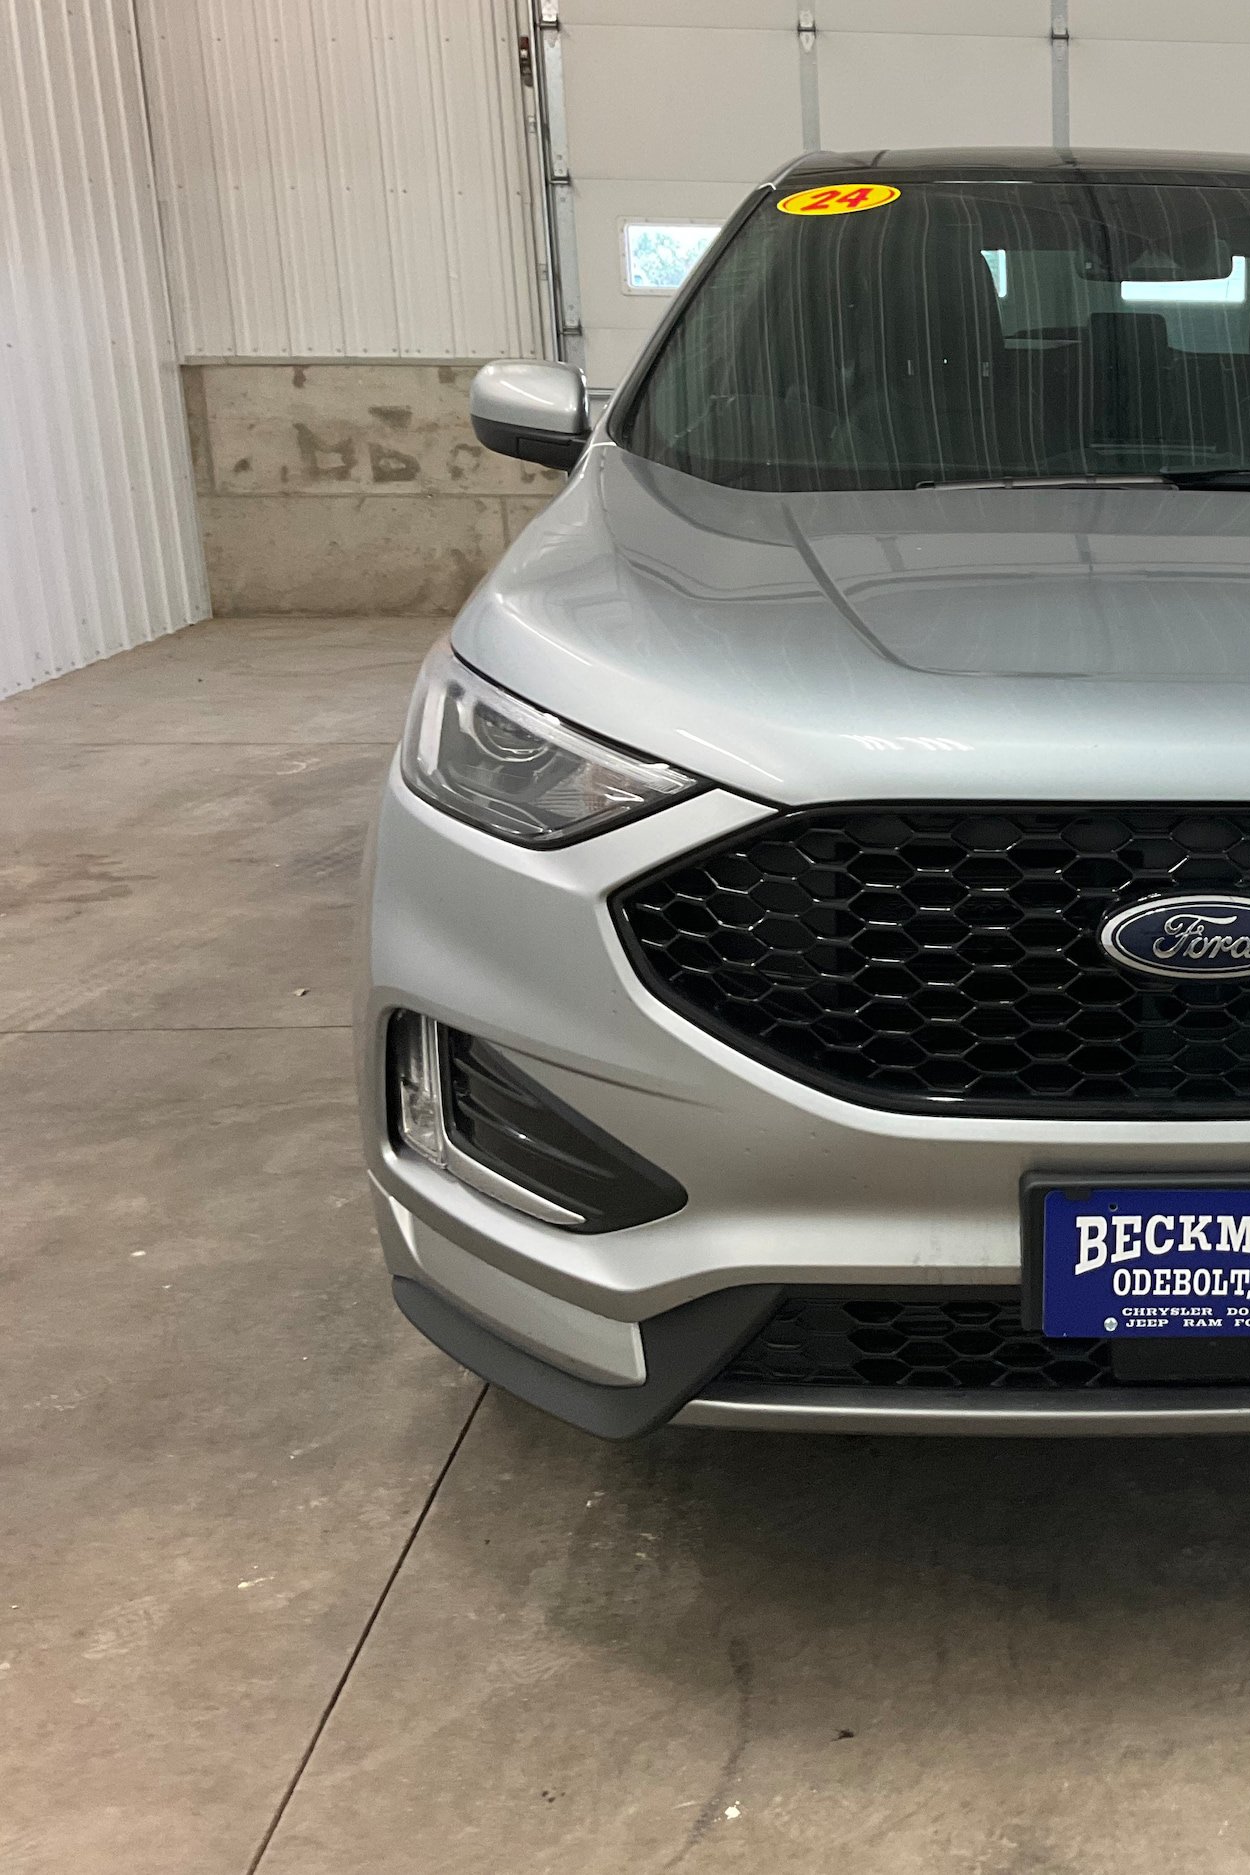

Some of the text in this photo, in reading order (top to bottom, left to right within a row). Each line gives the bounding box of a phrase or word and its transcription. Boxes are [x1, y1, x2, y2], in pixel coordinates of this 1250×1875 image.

[800, 188, 874, 211] 24
[1121, 1307, 1213, 1316] CHRYSLER
[1125, 1318, 1169, 1328] JEEP
[1183, 1318, 1223, 1327] RAM
